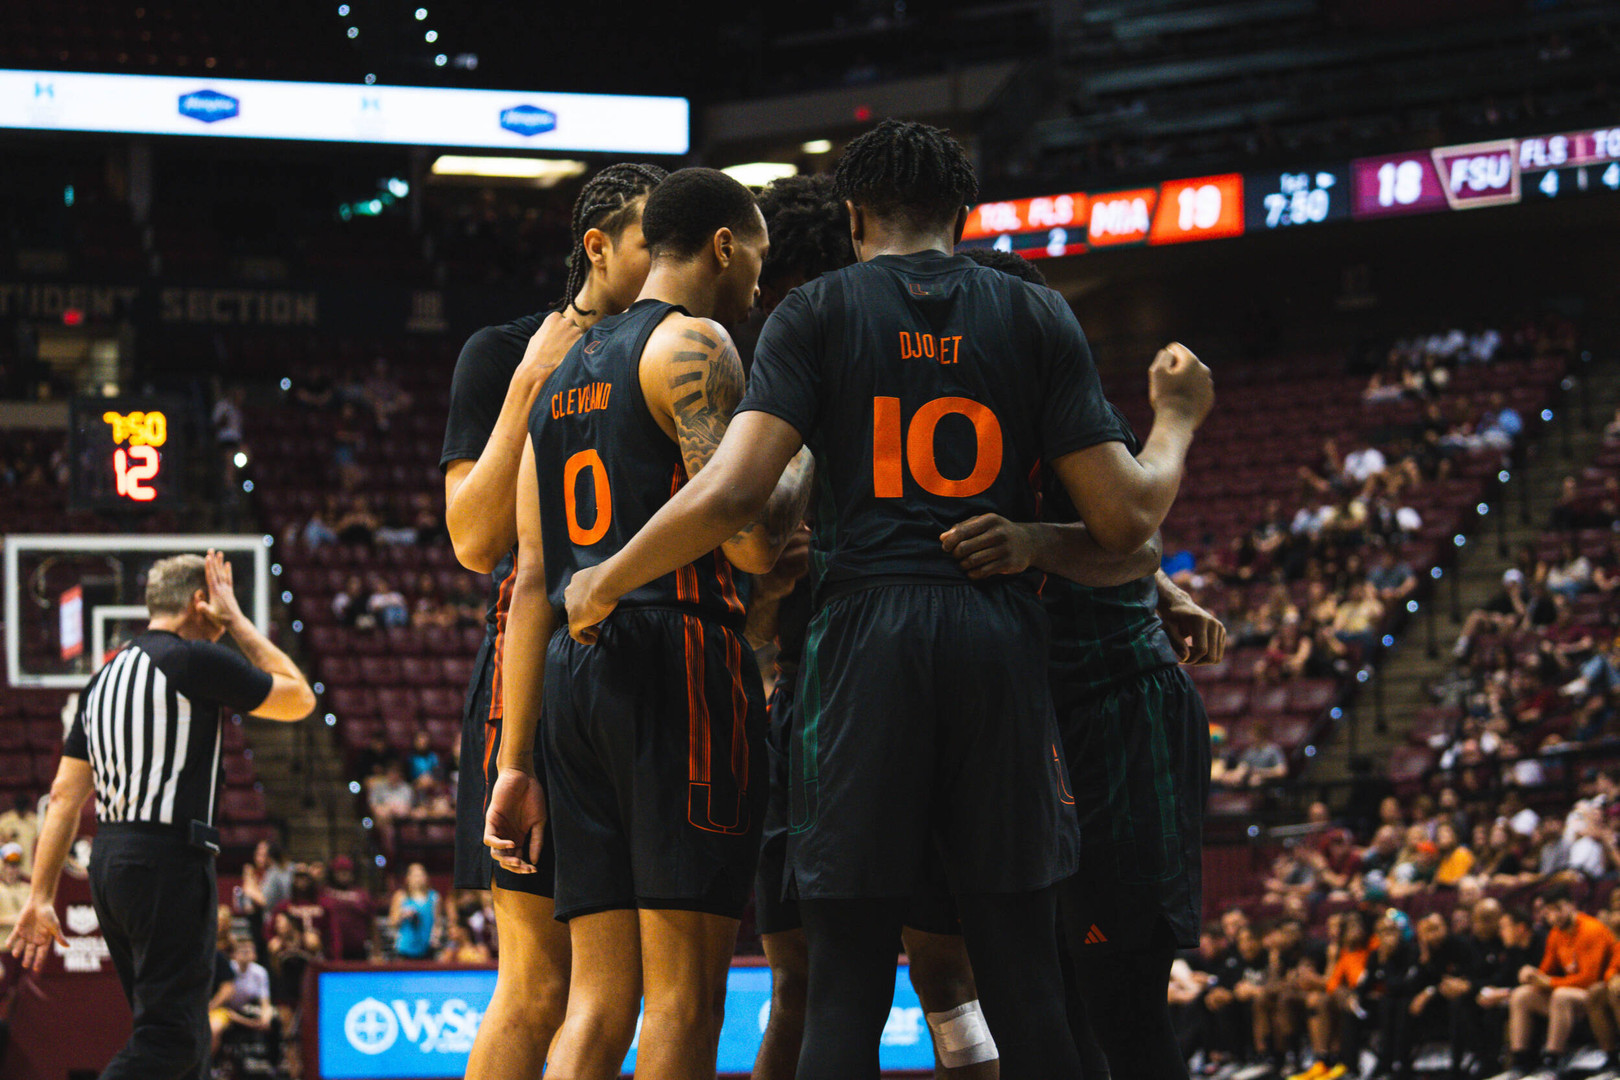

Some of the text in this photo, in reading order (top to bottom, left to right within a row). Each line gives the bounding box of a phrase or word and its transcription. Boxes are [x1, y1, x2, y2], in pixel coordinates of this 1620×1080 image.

[1519, 136, 1568, 168] FLS
[1378, 152, 1512, 207] 18 FSU
[1539, 169, 1560, 198] 4
[1028, 195, 1074, 226] FLS
[1091, 198, 1150, 238] MIA
[1264, 187, 1330, 228] 7:50
[1047, 228, 1068, 257] 2
[898, 331, 963, 365] DJOET
[103, 411, 168, 447] 7:50
[872, 396, 1004, 499] 10
[113, 445, 160, 502] 12
[564, 448, 613, 546] 0
[390, 997, 484, 1053] VySt
